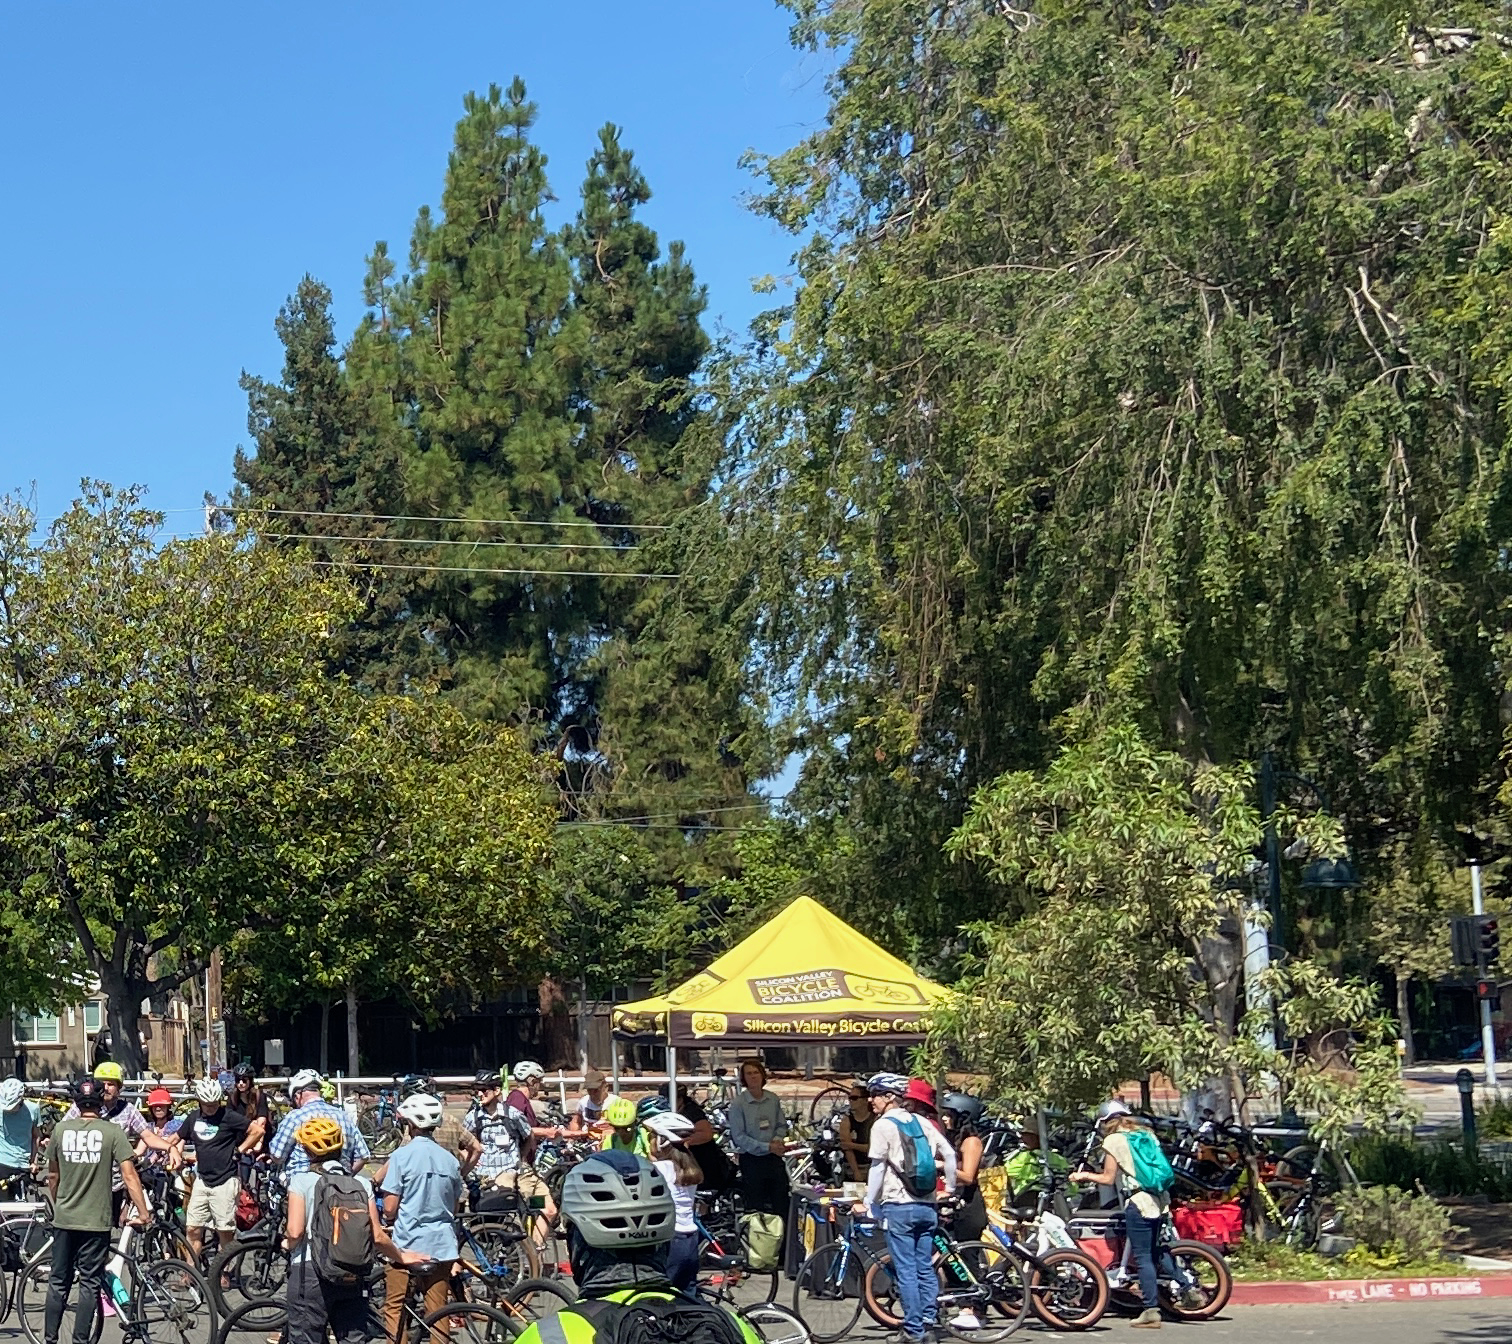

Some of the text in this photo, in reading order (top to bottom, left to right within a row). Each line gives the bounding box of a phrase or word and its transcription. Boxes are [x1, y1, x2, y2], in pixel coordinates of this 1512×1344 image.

[755, 971, 833, 987] SILICON VALLEY
[758, 978, 839, 997] BICYCLE
[761, 989, 842, 1004] COALITION
[743, 1018, 791, 1033] Silicon
[792, 1019, 836, 1037] Valley
[839, 1019, 890, 1036] Bicycle
[62, 1129, 103, 1152] REC
[63, 1151, 101, 1163] TEAM
[1360, 1281, 1394, 1299] LANE
[1409, 1283, 1428, 1296] NO
[1430, 1281, 1482, 1296] PARKING
